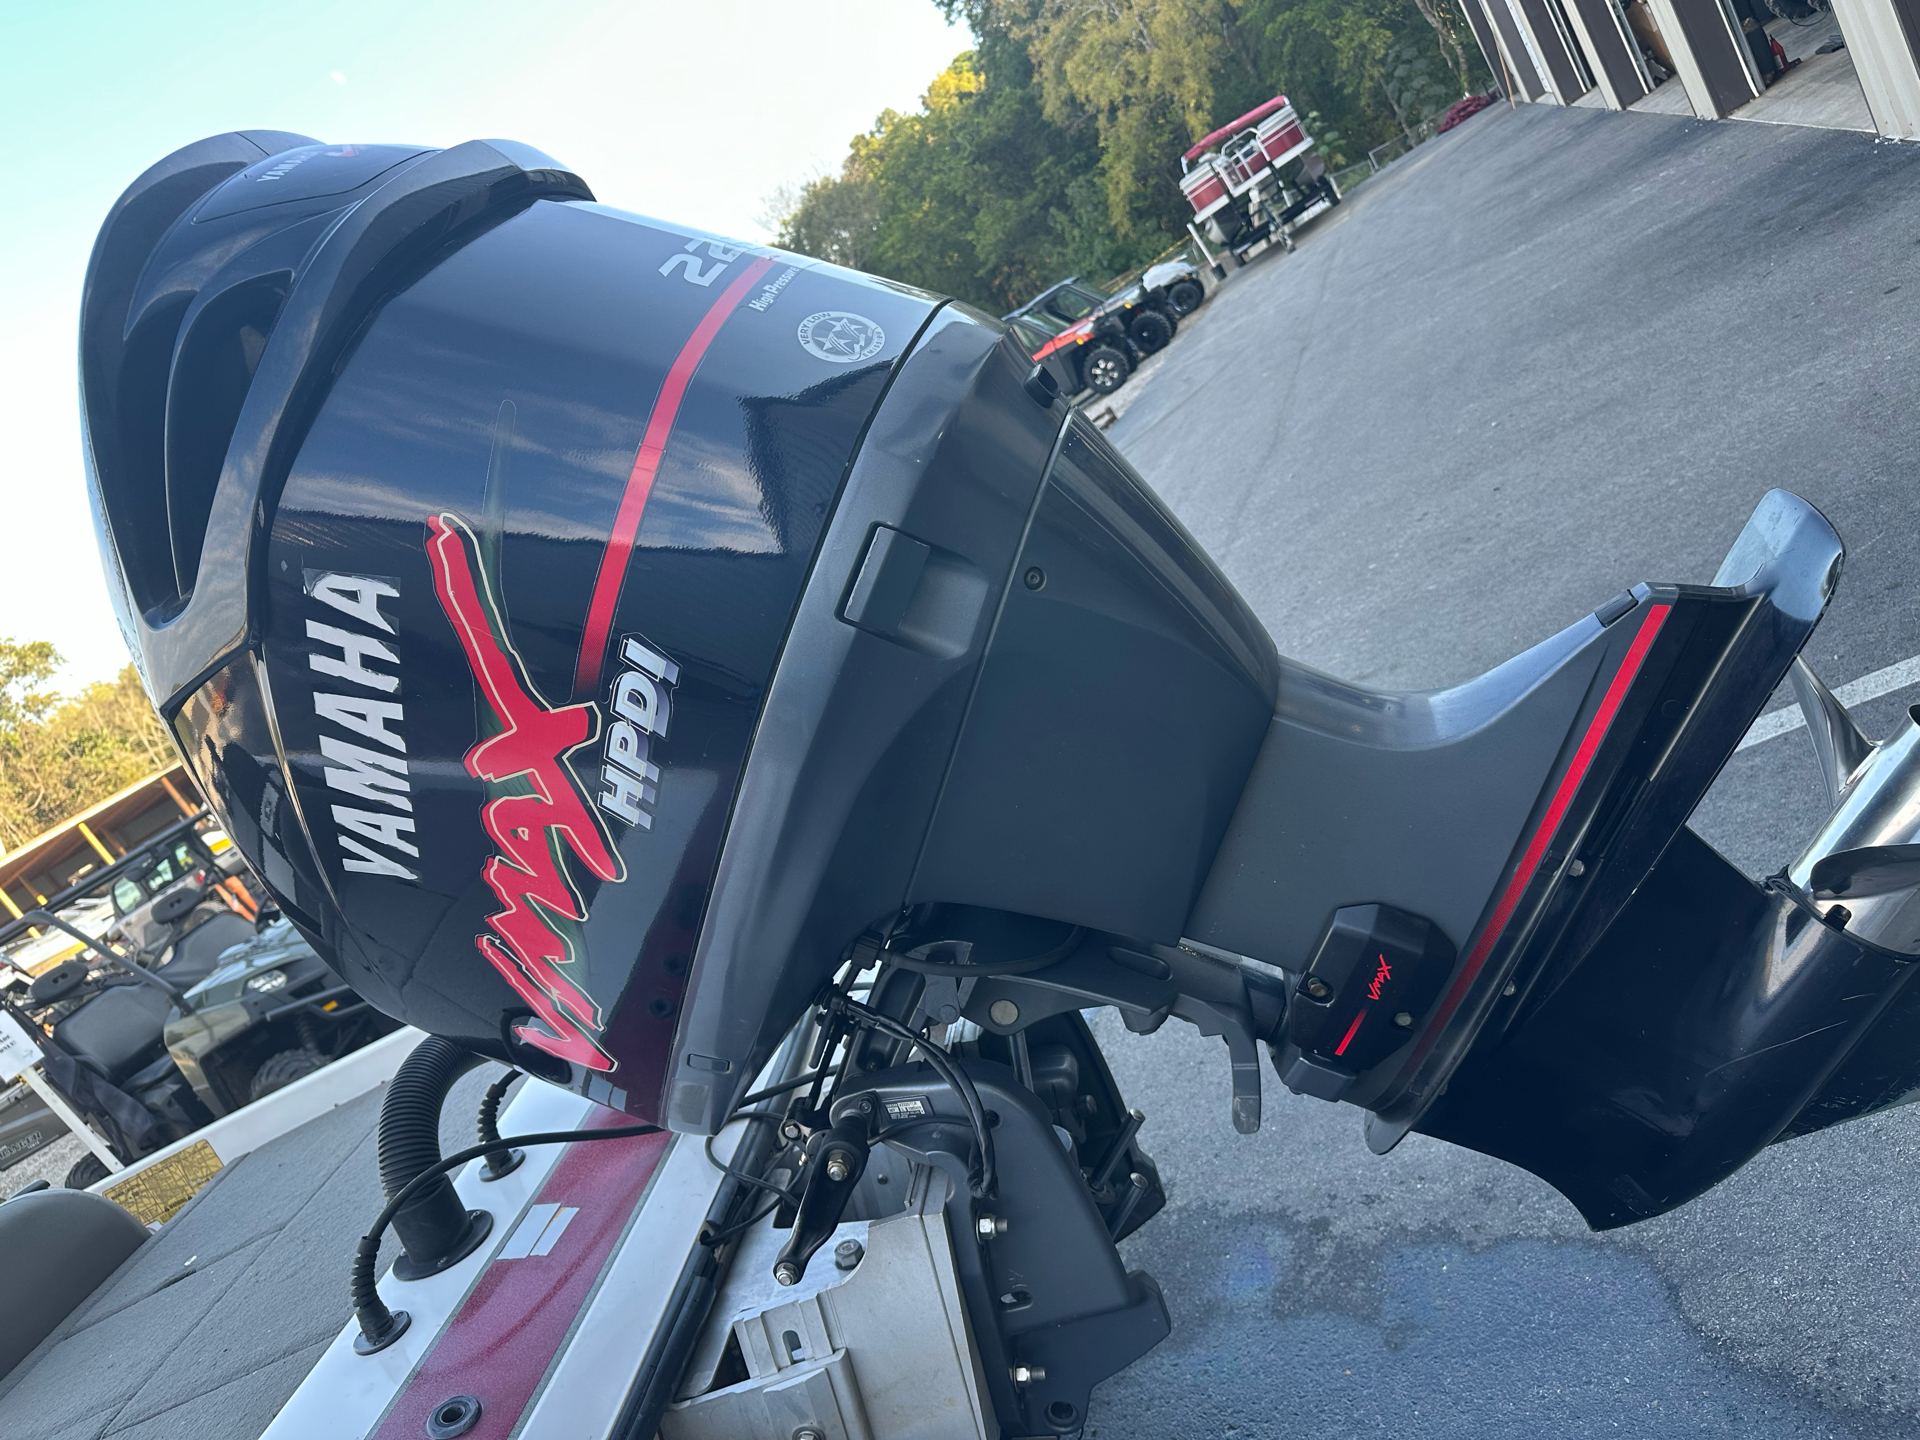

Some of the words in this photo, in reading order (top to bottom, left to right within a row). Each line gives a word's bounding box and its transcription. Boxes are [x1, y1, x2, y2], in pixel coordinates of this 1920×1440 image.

[748, 291, 774, 312] High
[762, 265, 800, 297] Pressure
[305, 571, 420, 881] YAMAHA
[597, 636, 682, 831] HPDI
